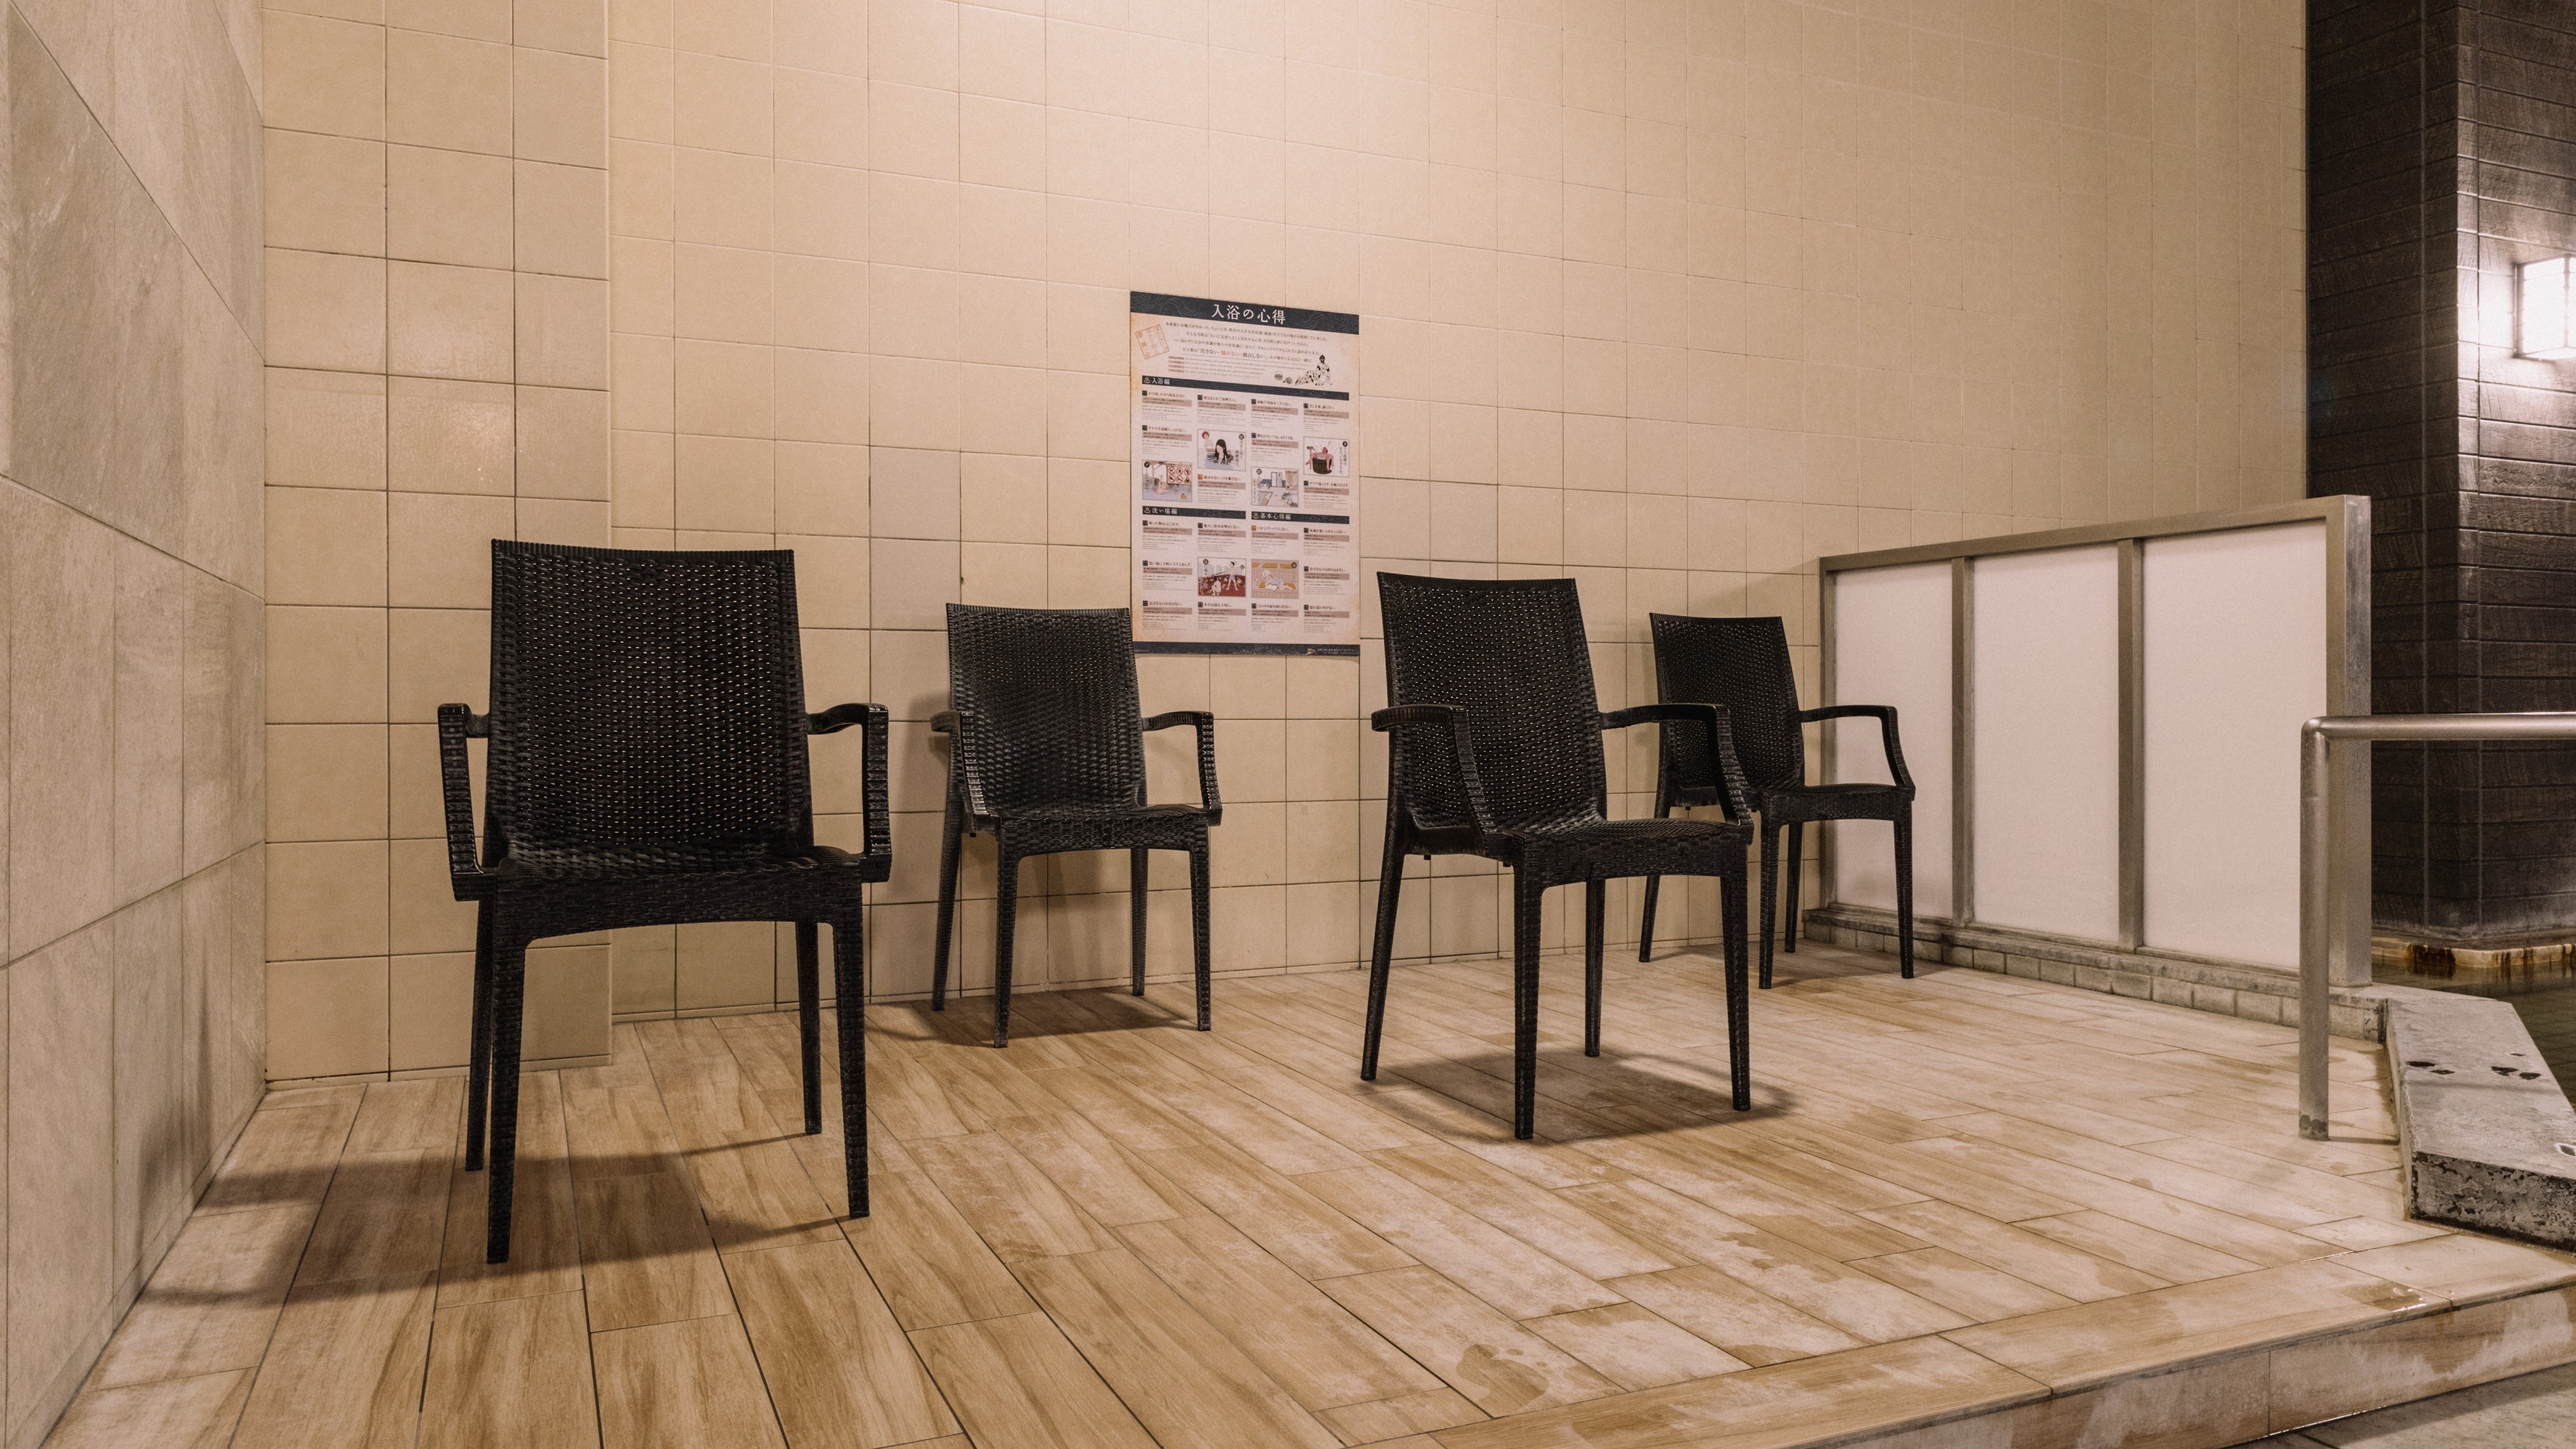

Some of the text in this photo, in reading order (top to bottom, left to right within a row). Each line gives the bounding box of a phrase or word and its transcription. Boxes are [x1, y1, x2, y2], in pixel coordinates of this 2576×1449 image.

[1211, 305, 1285, 325] 入浴の心得
[1260, 512, 1291, 520] 基本心得編
